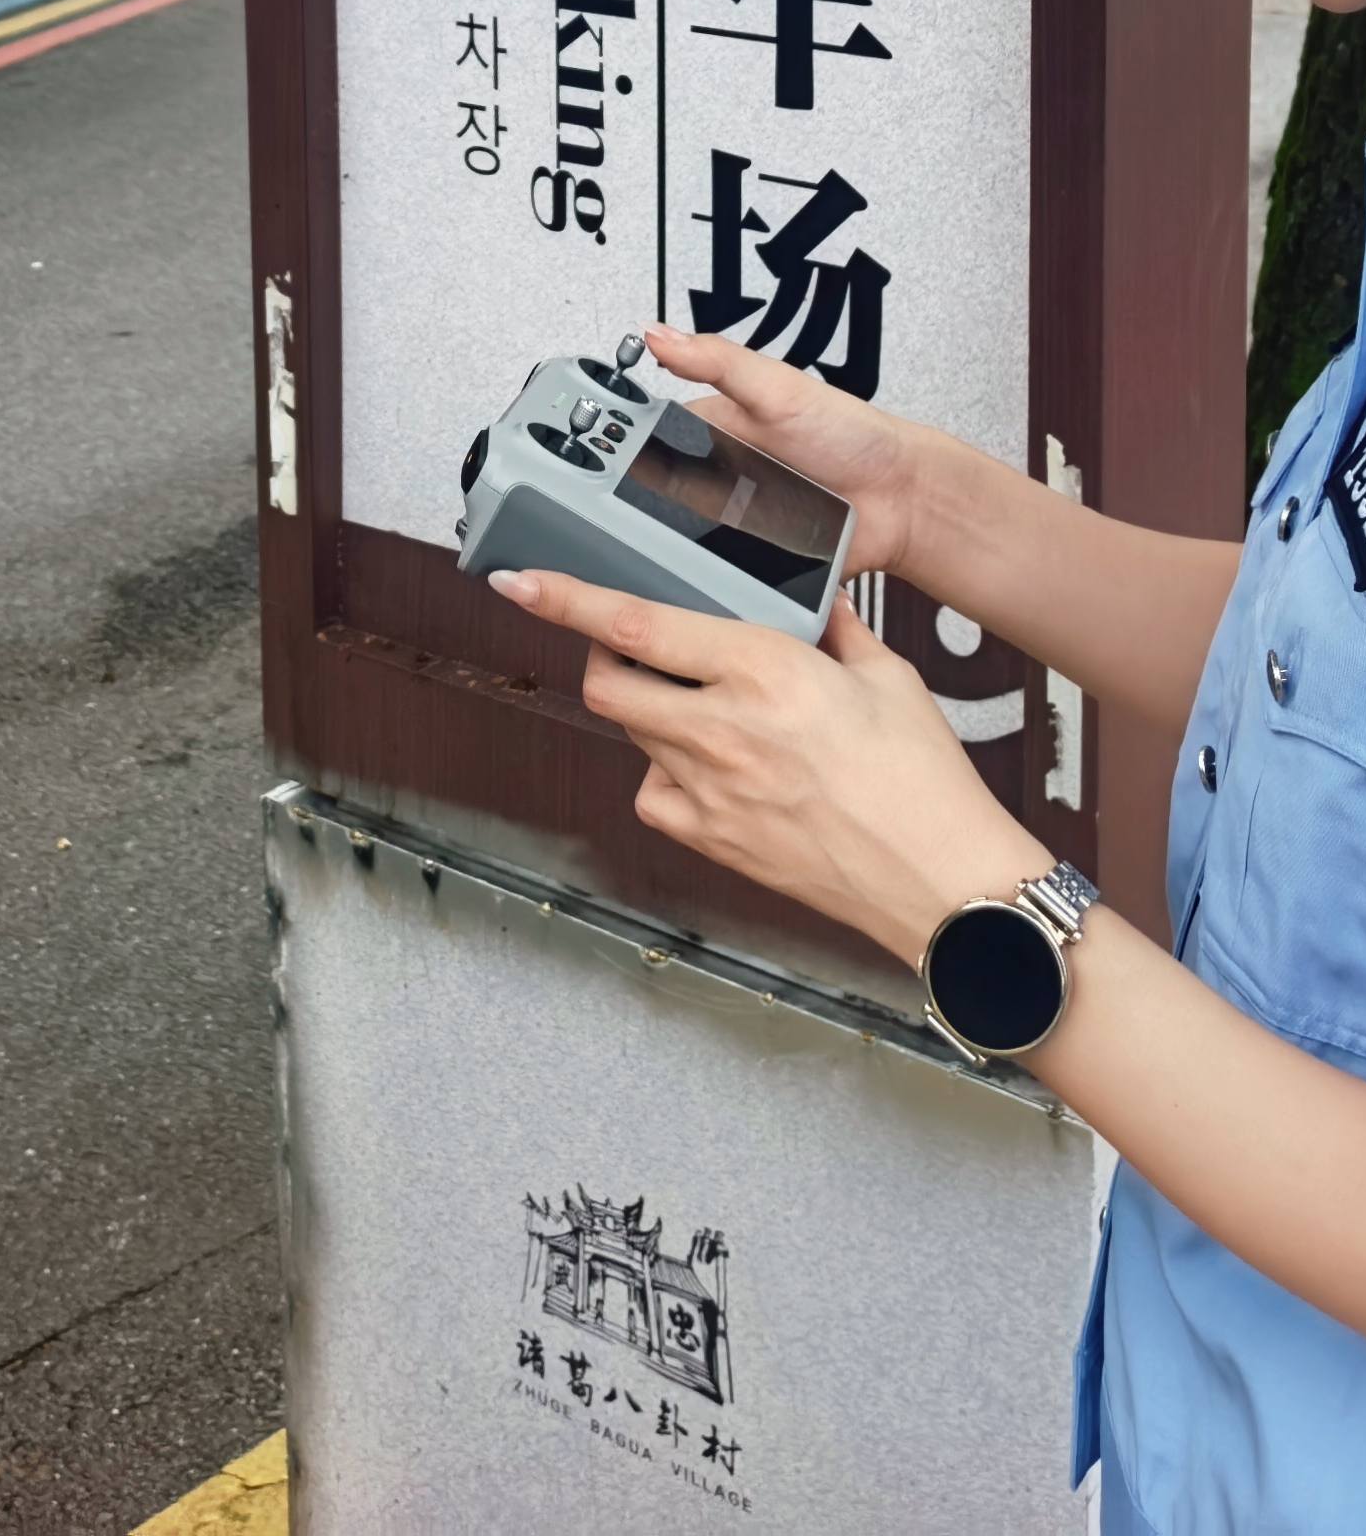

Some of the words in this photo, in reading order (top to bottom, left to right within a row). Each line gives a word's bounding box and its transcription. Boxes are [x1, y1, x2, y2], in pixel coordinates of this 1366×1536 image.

[513, 1378, 573, 1421] ZHUGE
[590, 1417, 653, 1462] BAGUA
[671, 1461, 754, 1515] VILLAGE
